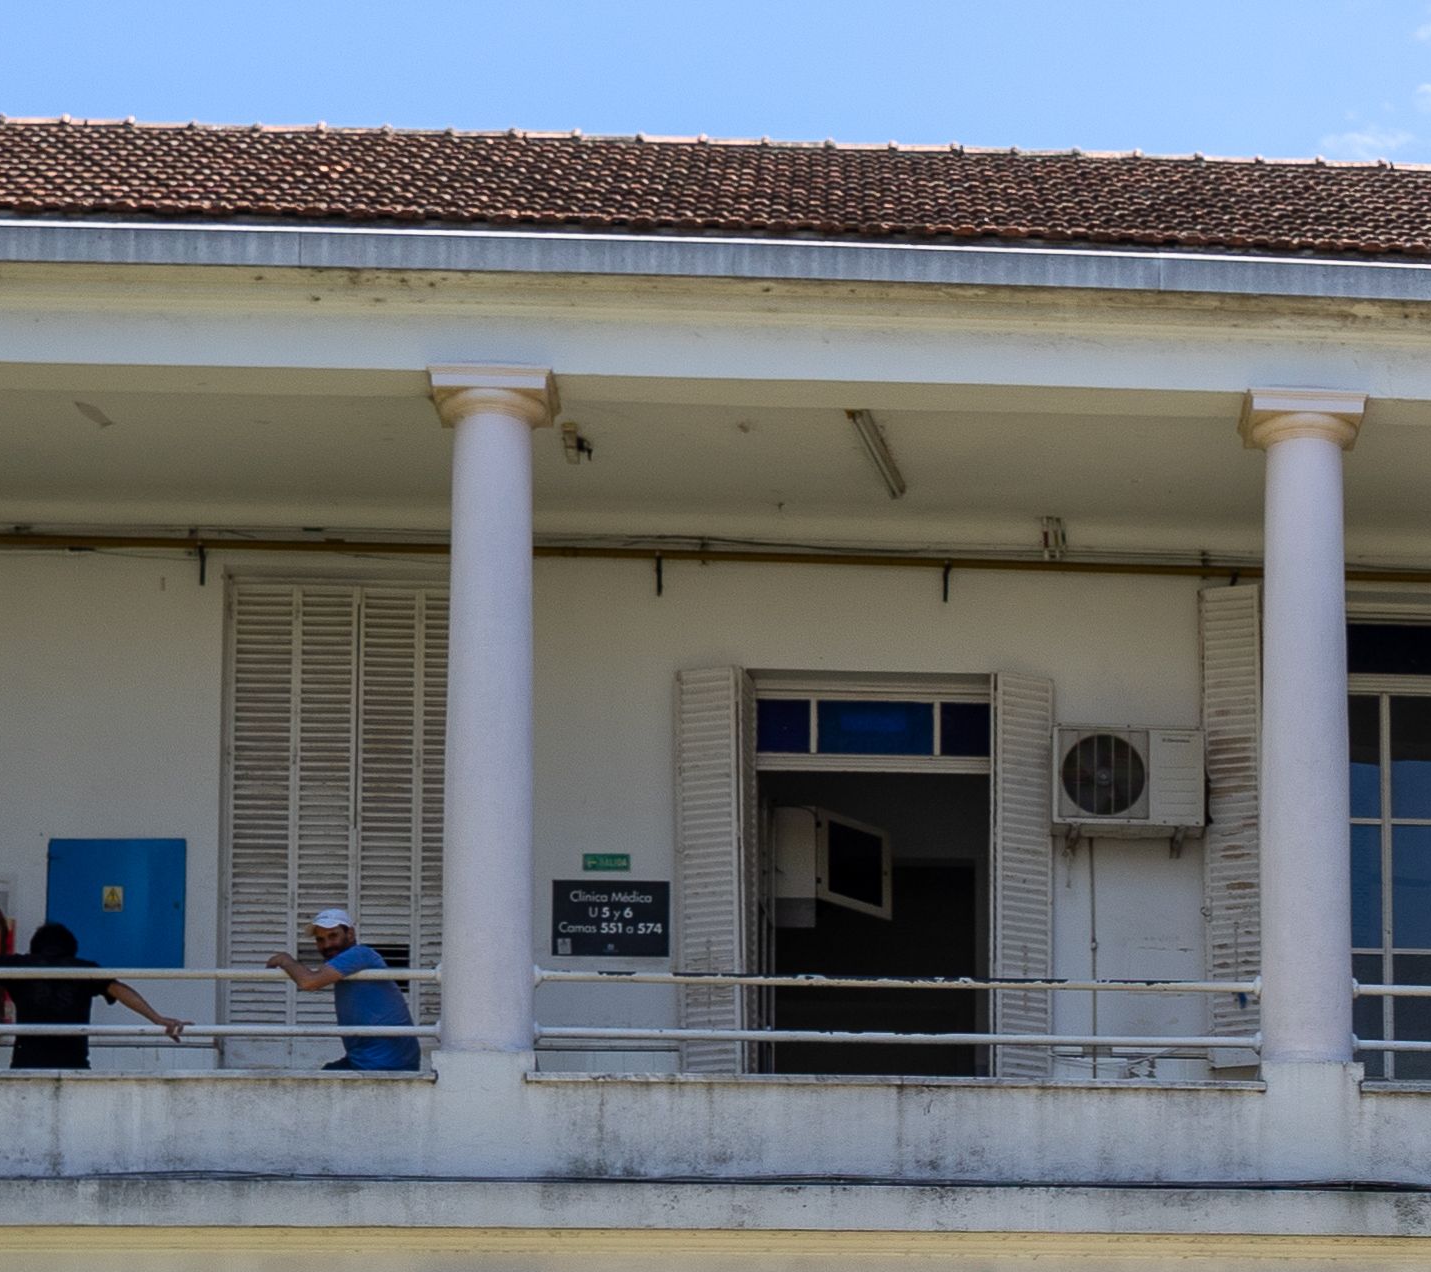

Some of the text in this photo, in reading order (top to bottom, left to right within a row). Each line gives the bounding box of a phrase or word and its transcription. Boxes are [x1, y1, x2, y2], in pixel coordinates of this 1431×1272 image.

[589, 906, 633, 920] U 5 y 6
[558, 922, 663, 934] Camas 551 a 574
